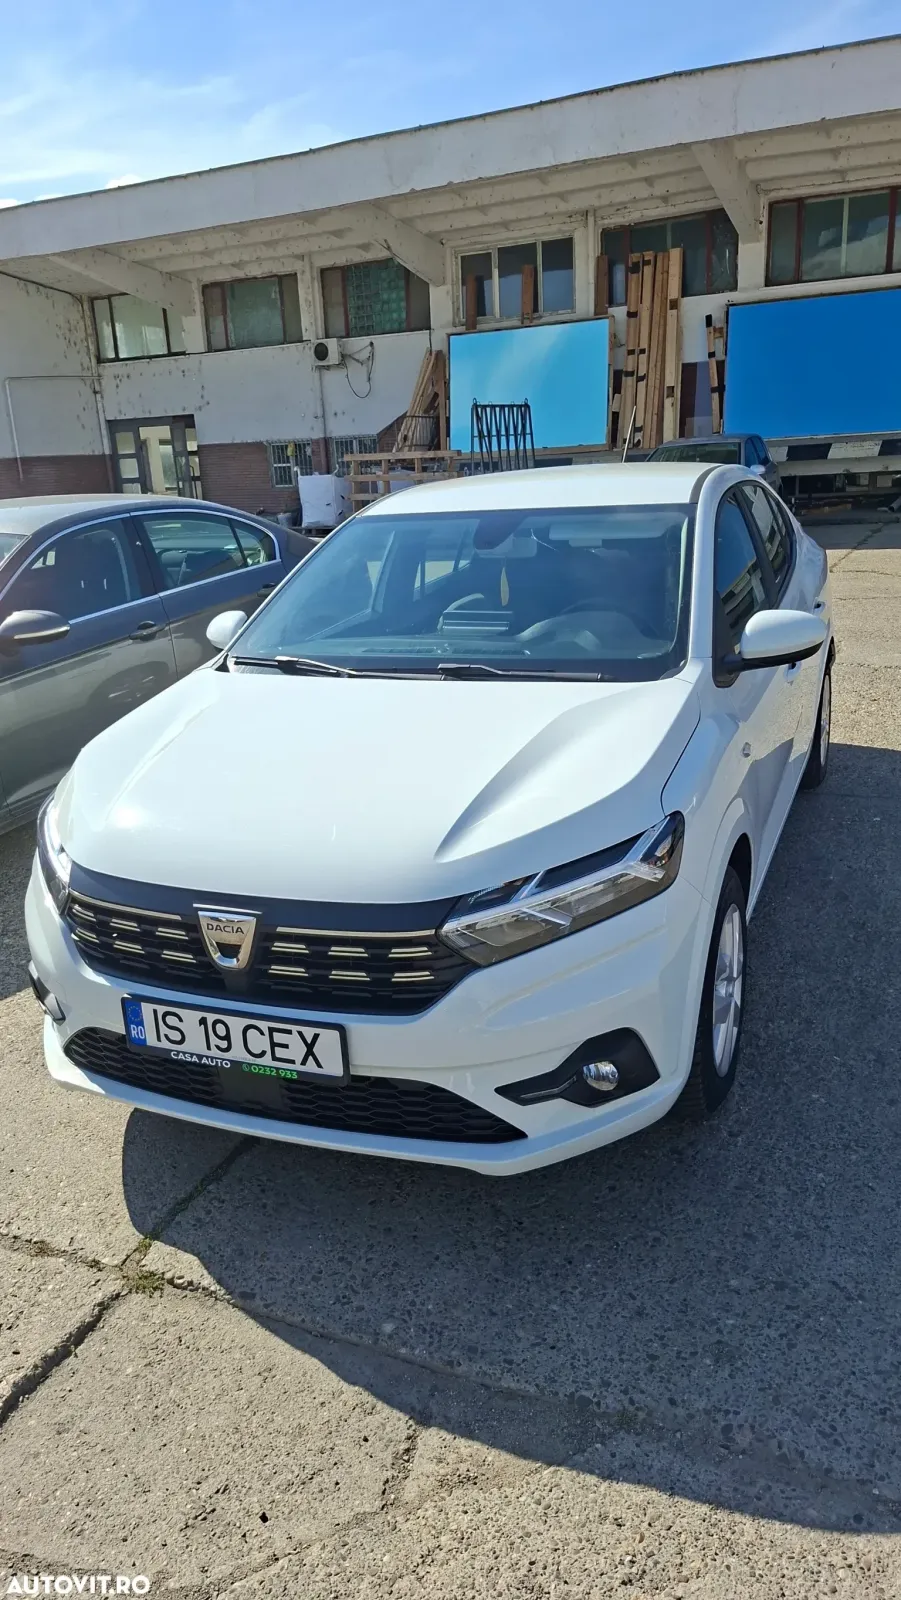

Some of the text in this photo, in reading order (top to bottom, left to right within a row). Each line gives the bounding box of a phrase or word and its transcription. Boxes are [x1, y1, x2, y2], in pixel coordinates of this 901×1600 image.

[206, 922, 245, 935] DACIA
[130, 1024, 146, 1040] RO
[152, 1008, 324, 1069] IS 19 CEX
[170, 1051, 199, 1063] CASA
[201, 1056, 231, 1069] AUTO
[250, 1064, 298, 1079] 0232 933
